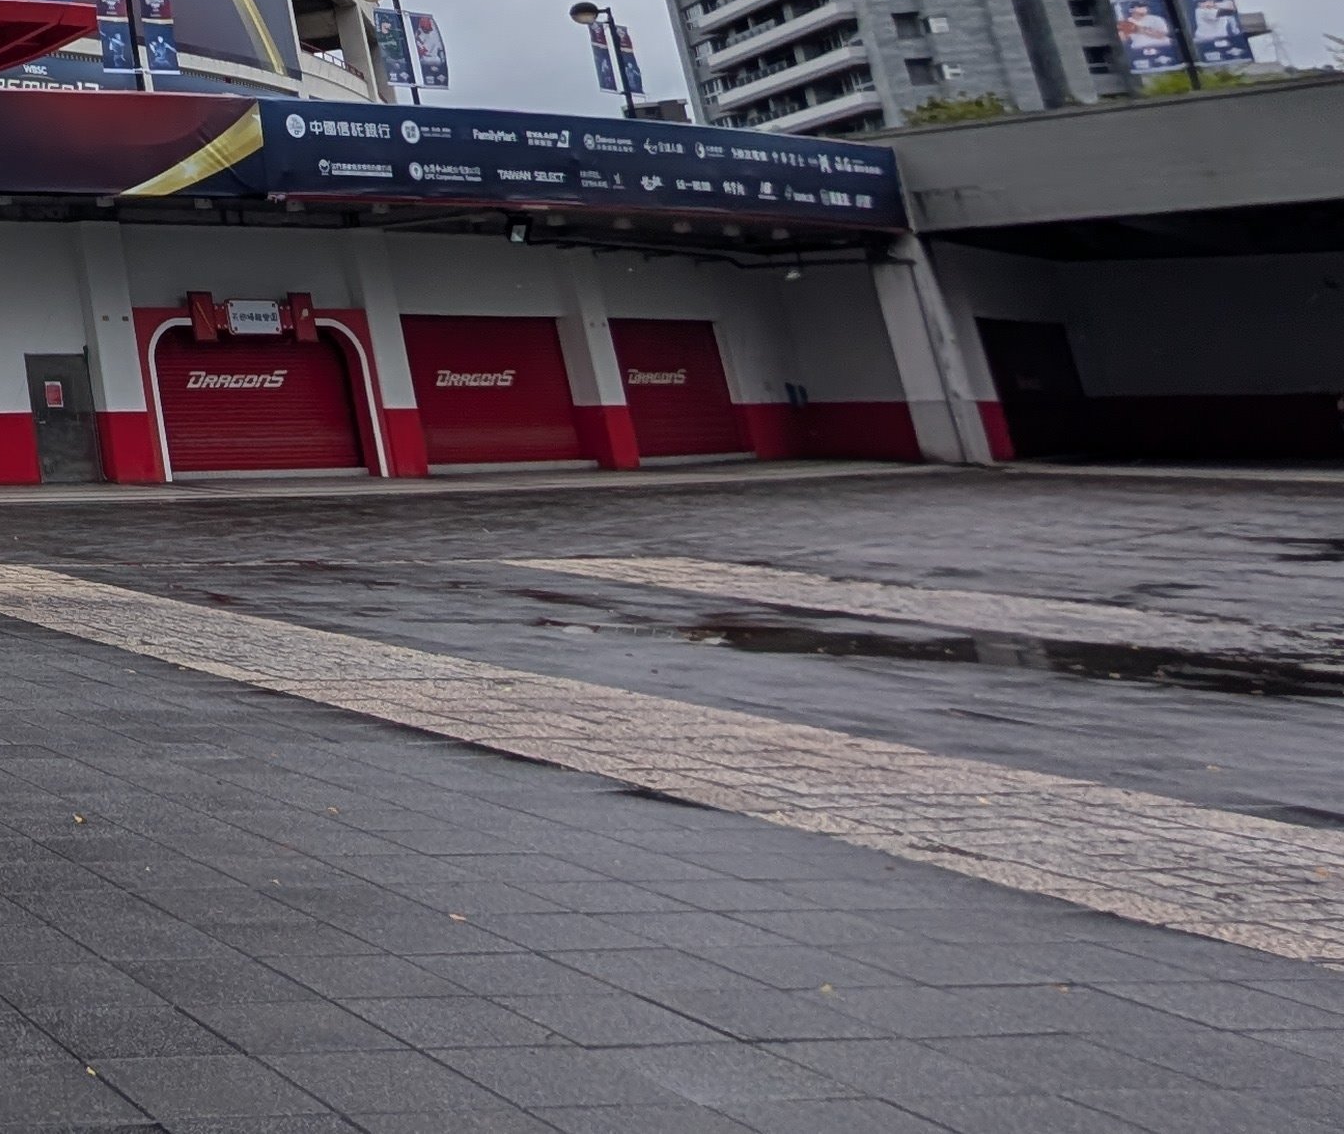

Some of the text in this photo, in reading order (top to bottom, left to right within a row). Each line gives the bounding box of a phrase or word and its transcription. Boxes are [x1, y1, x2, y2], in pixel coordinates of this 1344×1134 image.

[309, 120, 391, 139] 中國信託銀行
[497, 169, 531, 181] TAIWAN
[186, 369, 288, 389] DRAGONS
[436, 369, 515, 387] DRAGONS
[628, 368, 687, 385] DRAGONS
